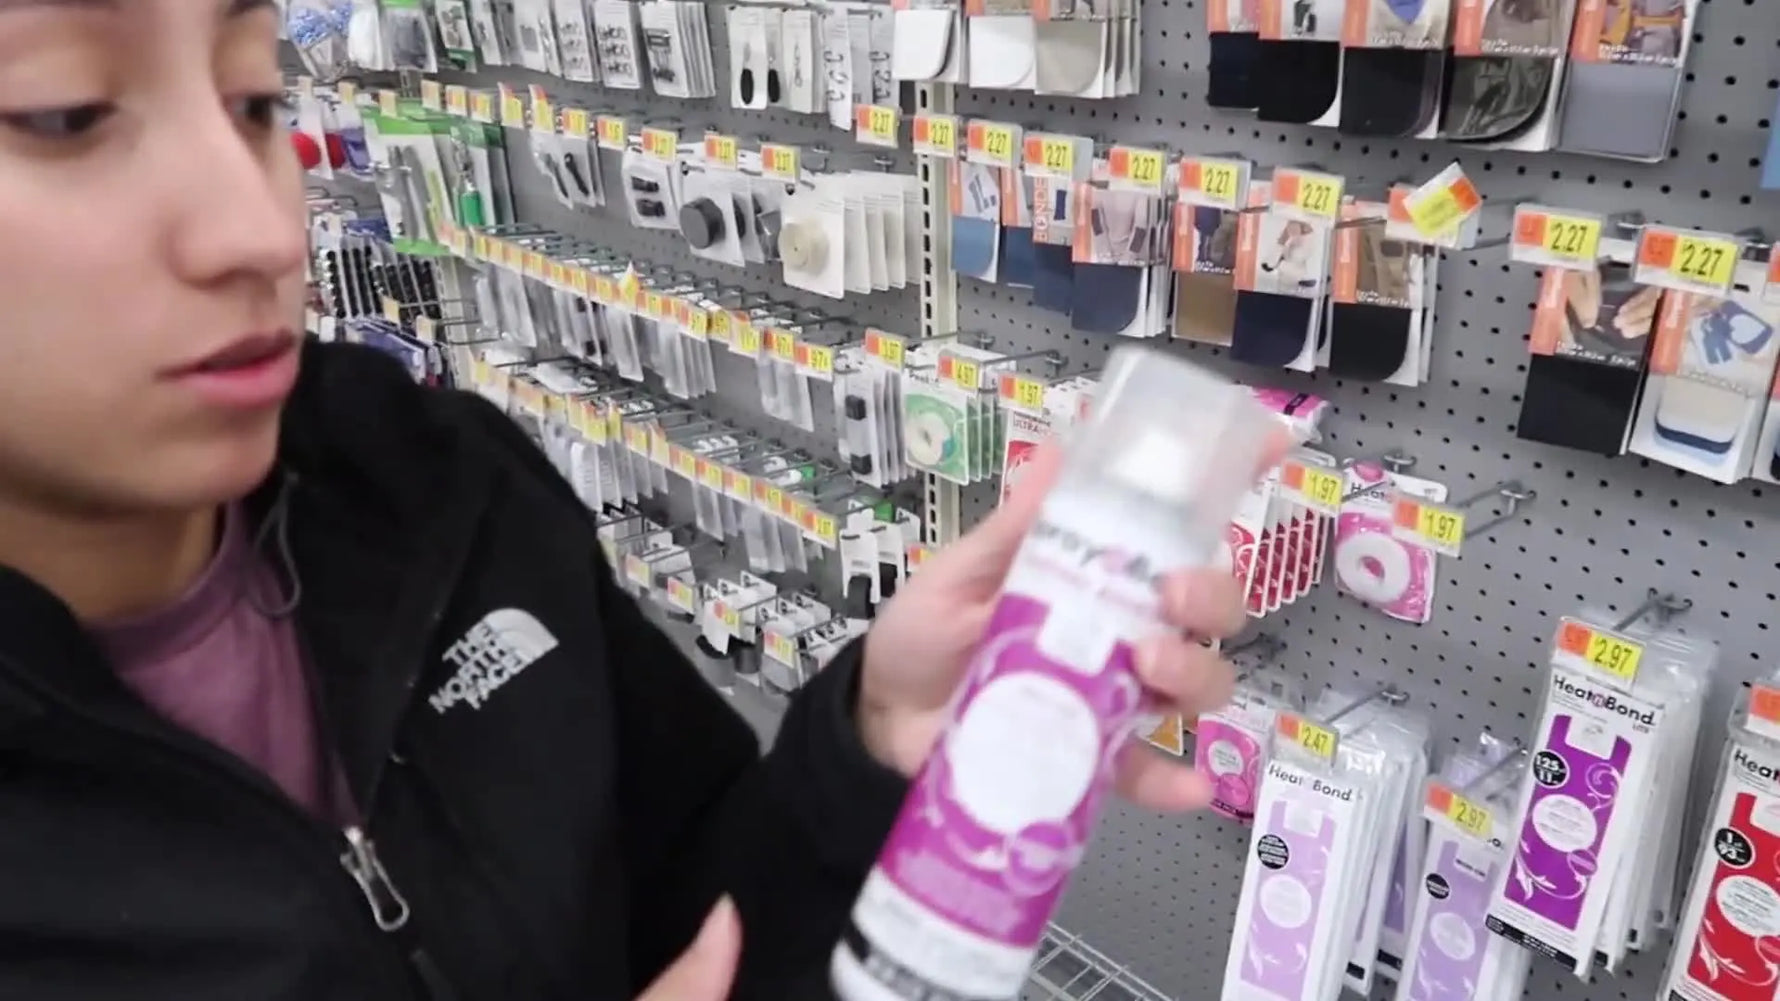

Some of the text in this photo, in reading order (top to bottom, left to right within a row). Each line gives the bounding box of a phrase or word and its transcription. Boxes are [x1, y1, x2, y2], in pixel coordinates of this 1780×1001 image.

[987, 131, 1007, 154] 2.27
[1045, 144, 1068, 168] 2.27
[1132, 155, 1156, 181] 2.27
[1205, 167, 1231, 194] 2.27
[1302, 183, 1332, 211] 2.27
[1550, 222, 1588, 253] 2.27
[1680, 243, 1724, 278] 2.27
[1310, 471, 1338, 501] 1.97
[1425, 509, 1457, 540] 1.97
[442, 620, 496, 665] THE
[1593, 637, 1633, 673] 2.97
[428, 639, 507, 714] NORTH
[464, 647, 526, 711] FACE
[1303, 726, 1329, 753] 2.47
[1312, 779, 1353, 802] Bond
[1456, 802, 1488, 831] 2.97
